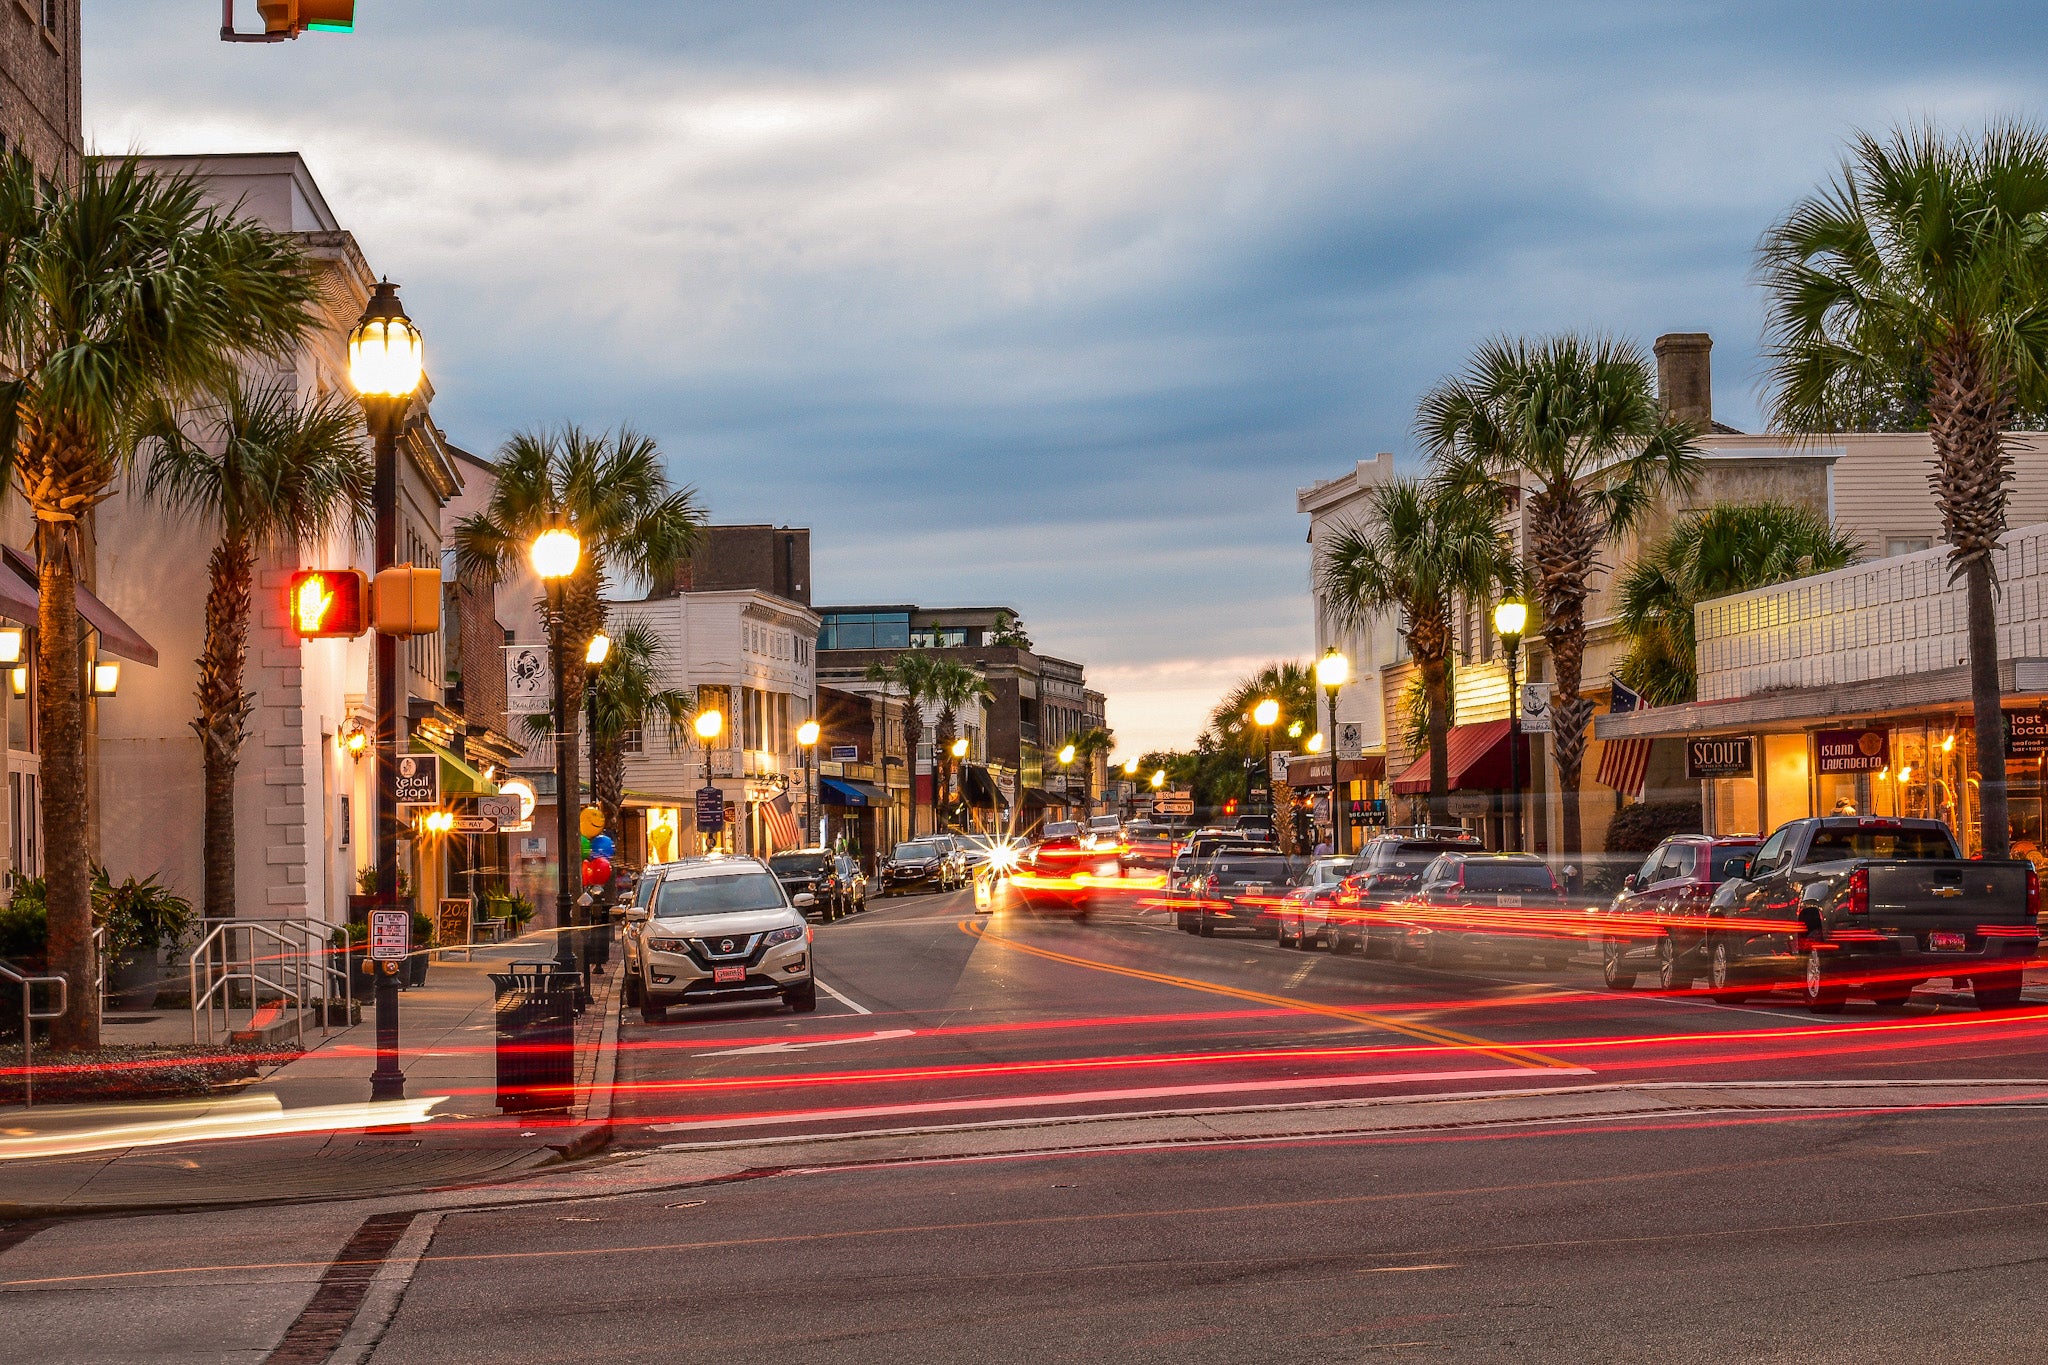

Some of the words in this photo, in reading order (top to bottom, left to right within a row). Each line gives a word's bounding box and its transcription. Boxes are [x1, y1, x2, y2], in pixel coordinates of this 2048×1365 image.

[2011, 714, 2041, 724] lost
[1694, 742, 1745, 765] SCOUT
[1821, 744, 1854, 756] ISLAND
[1822, 757, 1868, 771] LAVENDER
[1869, 757, 1884, 768] CO.
[396, 787, 433, 799] erapy
[1352, 800, 1383, 812] ART
[442, 904, 468, 917] 20%
[441, 919, 463, 929] OFF
